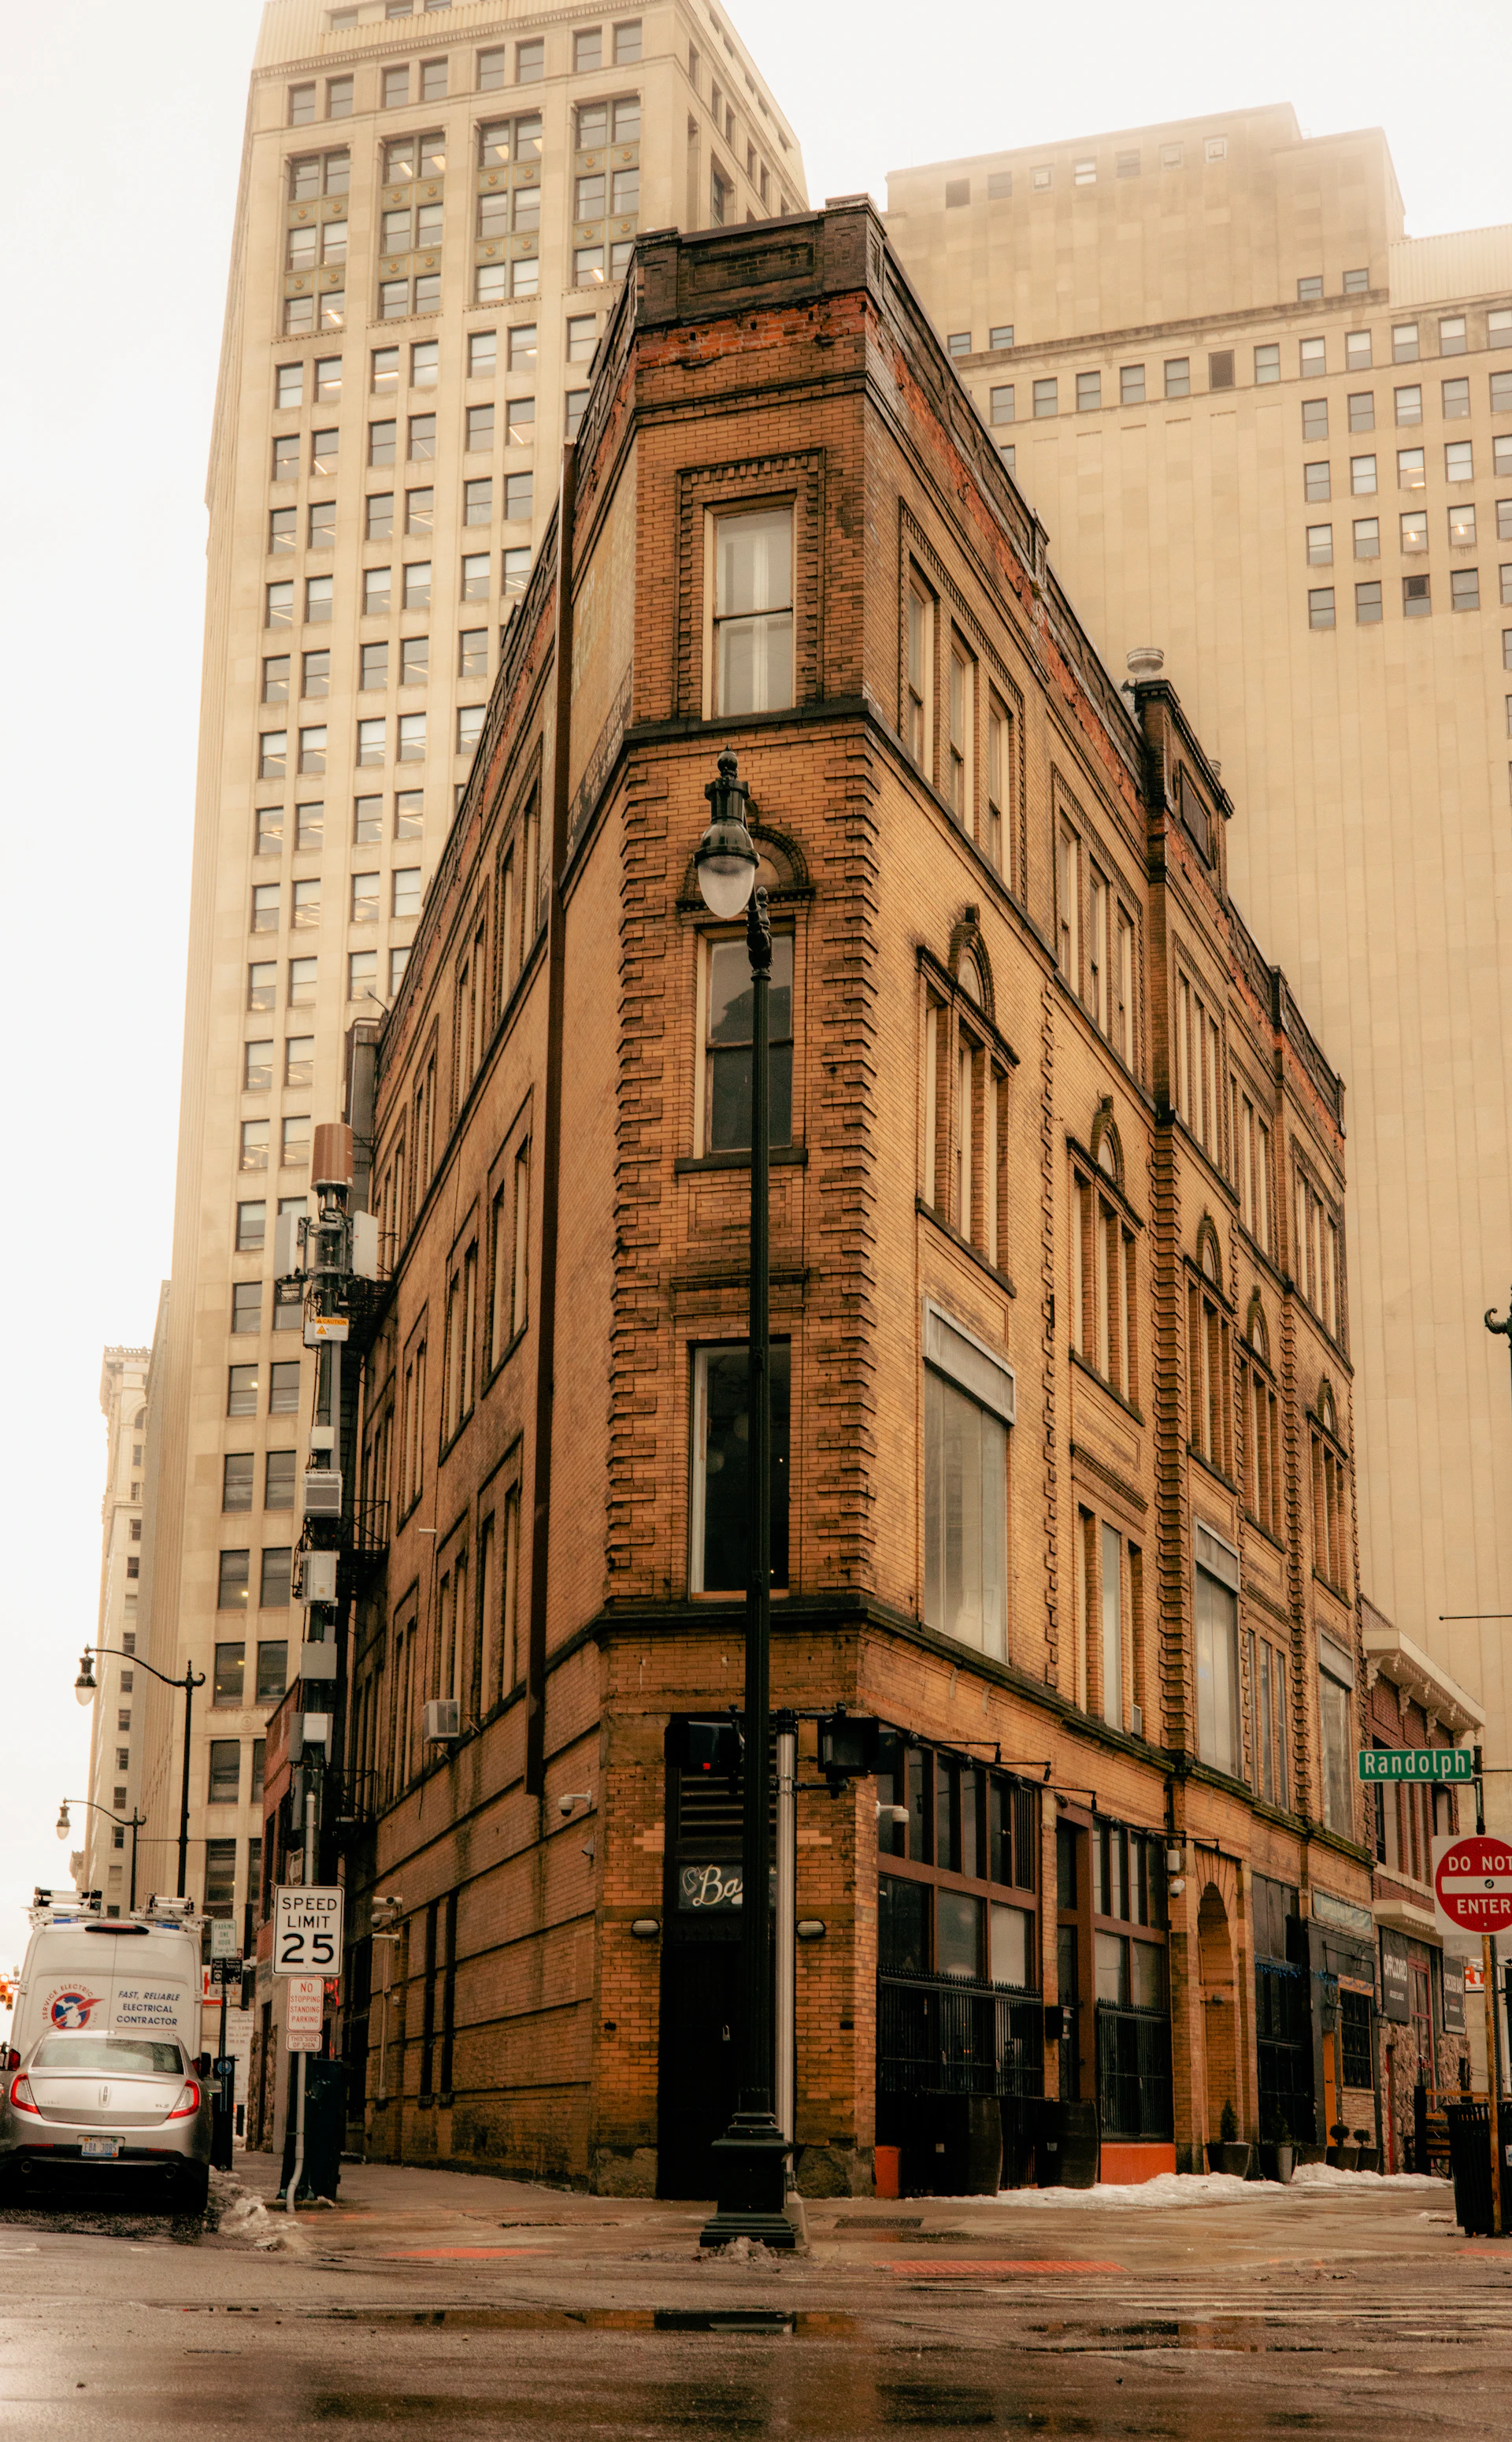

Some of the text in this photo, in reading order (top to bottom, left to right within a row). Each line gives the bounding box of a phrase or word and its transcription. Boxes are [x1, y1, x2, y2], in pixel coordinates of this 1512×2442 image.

[1364, 1750, 1466, 1779] Randolph
[1447, 1856, 1512, 1872] DO NOT
[282, 1898, 337, 1910] SPEED
[1457, 1899, 1512, 1914] ENTER
[287, 1916, 330, 1928] LIMIT
[281, 1933, 334, 1965] 25
[300, 1983, 313, 1993] NO
[118, 1991, 180, 2001] FAST, RELIABLE
[43, 1984, 94, 2021] SERVICE ELECTRIC
[123, 2003, 172, 2013] ELECTRICAL
[117, 2015, 177, 2025] CONTRACTOR
